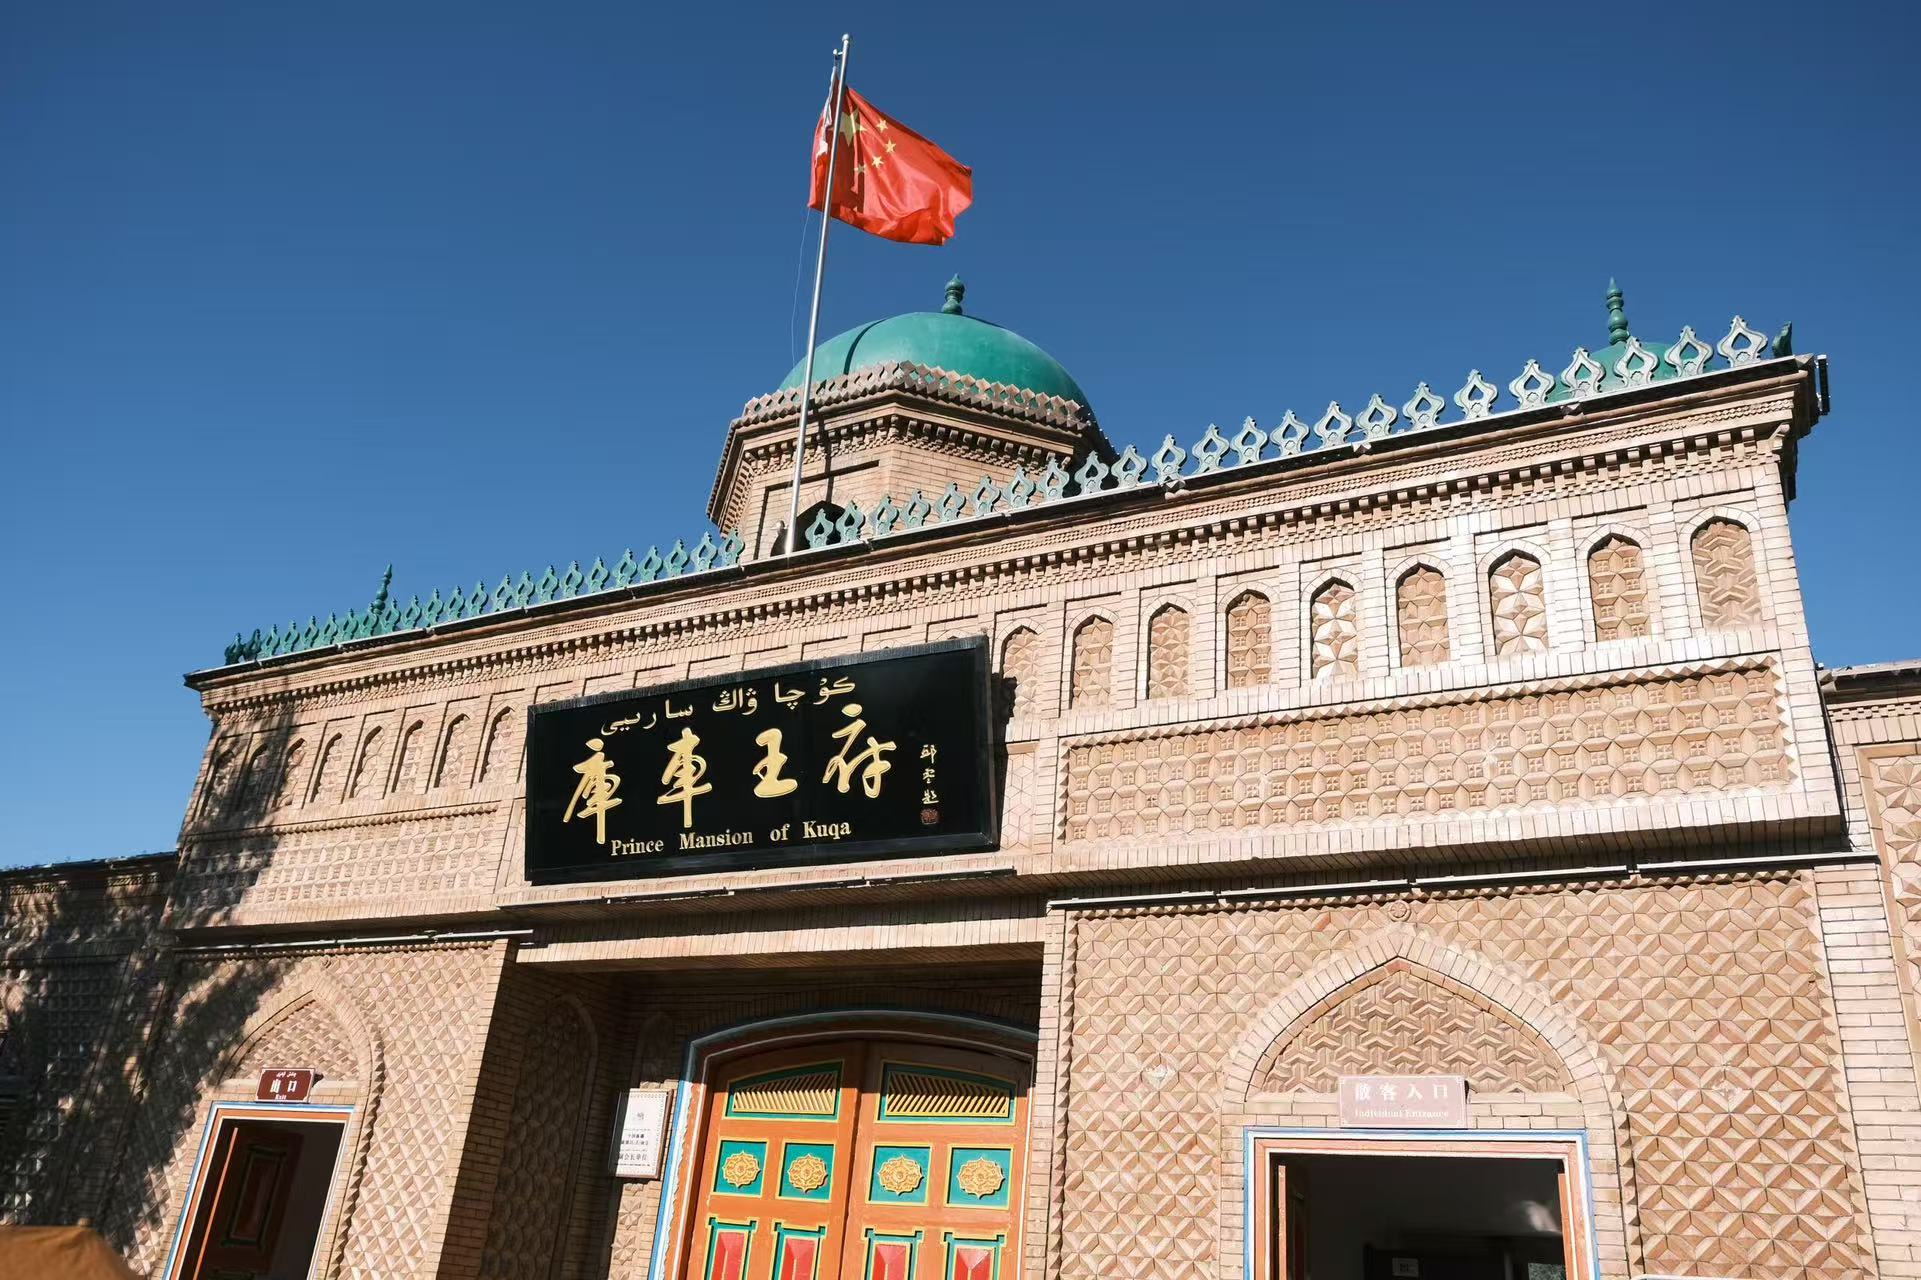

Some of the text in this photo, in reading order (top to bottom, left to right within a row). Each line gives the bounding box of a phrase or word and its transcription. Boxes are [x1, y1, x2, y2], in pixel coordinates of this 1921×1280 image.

[610, 820, 852, 856] Prince Mansion of Kuqa
[1354, 1082, 1449, 1101] 散客入口
